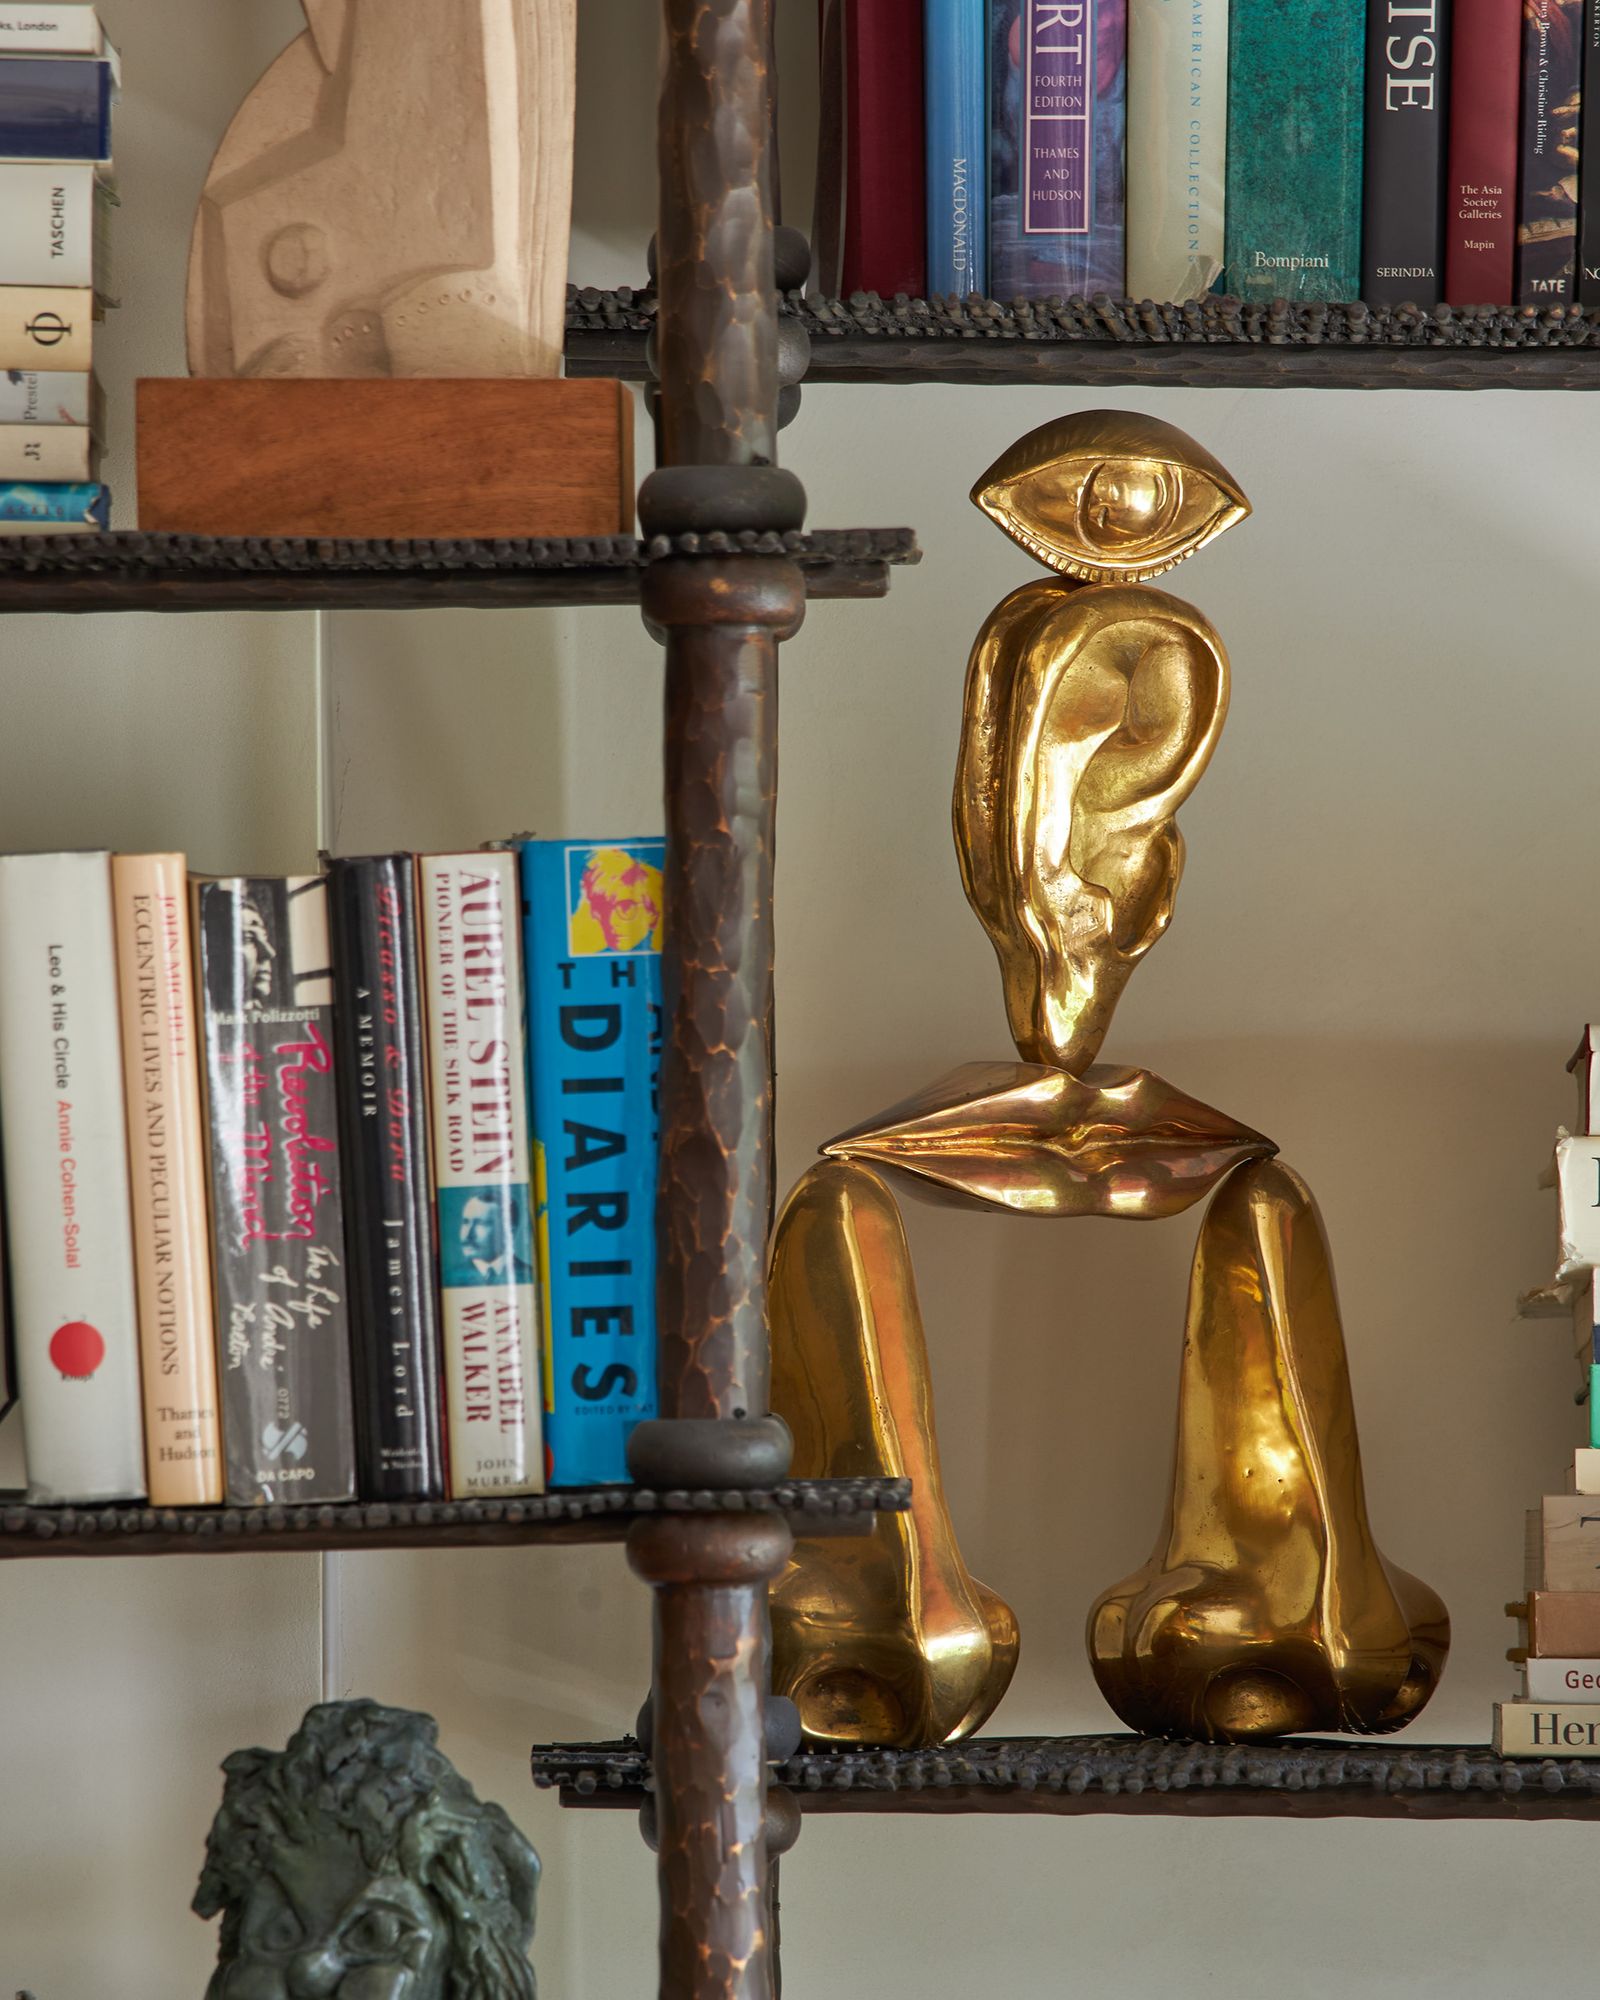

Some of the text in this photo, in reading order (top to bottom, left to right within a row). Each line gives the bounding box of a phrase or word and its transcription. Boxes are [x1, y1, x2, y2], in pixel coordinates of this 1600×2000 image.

[18, 21, 59, 31] London
[1035, 3, 1083, 65] RT
[1540, 21, 1551, 56] Brown
[1035, 75, 1082, 88] FOURTH
[1539, 58, 1549, 67] &
[1034, 96, 1082, 108] EDITION
[1538, 69, 1549, 118] Christine
[1033, 147, 1080, 159] THAMES
[1188, 0, 1203, 264] AMERICAN COLLECTIONS
[1534, 120, 1548, 155] Riding
[1032, 190, 1082, 201] HUDSON
[1043, 168, 1070, 180] AND
[1460, 185, 1503, 195] The Asia
[51, 186, 65, 259] TASCHEN
[952, 158, 968, 272] MACDONALD
[1458, 209, 1503, 219] Galleries
[1463, 198, 1499, 209] Society
[1254, 251, 1330, 271] Bompiani
[1464, 240, 1496, 252] Mapin
[1376, 267, 1436, 278] SERINDIA
[1531, 279, 1567, 294] TATE
[24, 373, 38, 421] Prestel
[155, 893, 179, 951] JOHN
[375, 882, 402, 1025] Picasso
[212, 1008, 320, 1026] Mark Polizzotti
[435, 872, 467, 1174] PIONEER OF THE SILK ROAD
[459, 870, 516, 1176] AUREL STEIN
[357, 987, 378, 1118] A MEMOIR
[48, 944, 82, 1269] Leo & His Circle Annie Cohen-Solal
[133, 894, 180, 1377] ECCENTRIC LIVES AND PECULIAR NOTIONS
[274, 1022, 336, 1241] Revolution
[386, 1086, 410, 1182] Dora
[558, 1003, 638, 1402] DIARIES
[258, 1265, 299, 1288] of
[286, 1245, 341, 1330] The Life
[227, 1302, 258, 1371] Breton
[383, 1219, 414, 1417] James Lord
[460, 1301, 492, 1423] WALKER
[494, 1299, 525, 1434] ANNABEL
[257, 1467, 316, 1483] DA CAPO
[475, 1458, 517, 1472] JOHN
